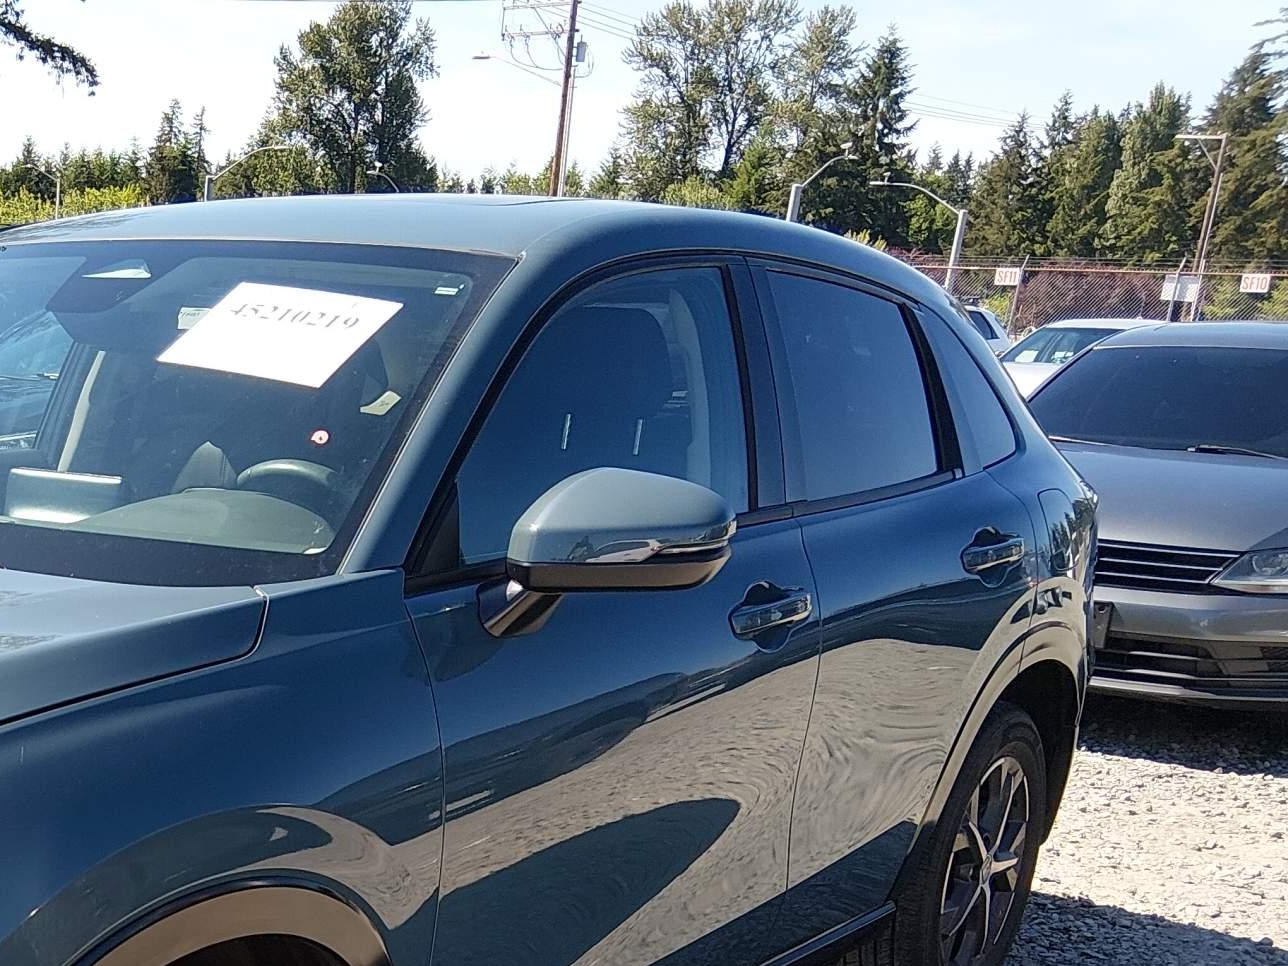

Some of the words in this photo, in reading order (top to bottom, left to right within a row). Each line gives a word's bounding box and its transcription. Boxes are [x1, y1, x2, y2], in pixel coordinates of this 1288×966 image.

[996, 269, 1018, 283] SF11
[1242, 276, 1268, 291] SF10
[230, 303, 360, 329] 45210219
